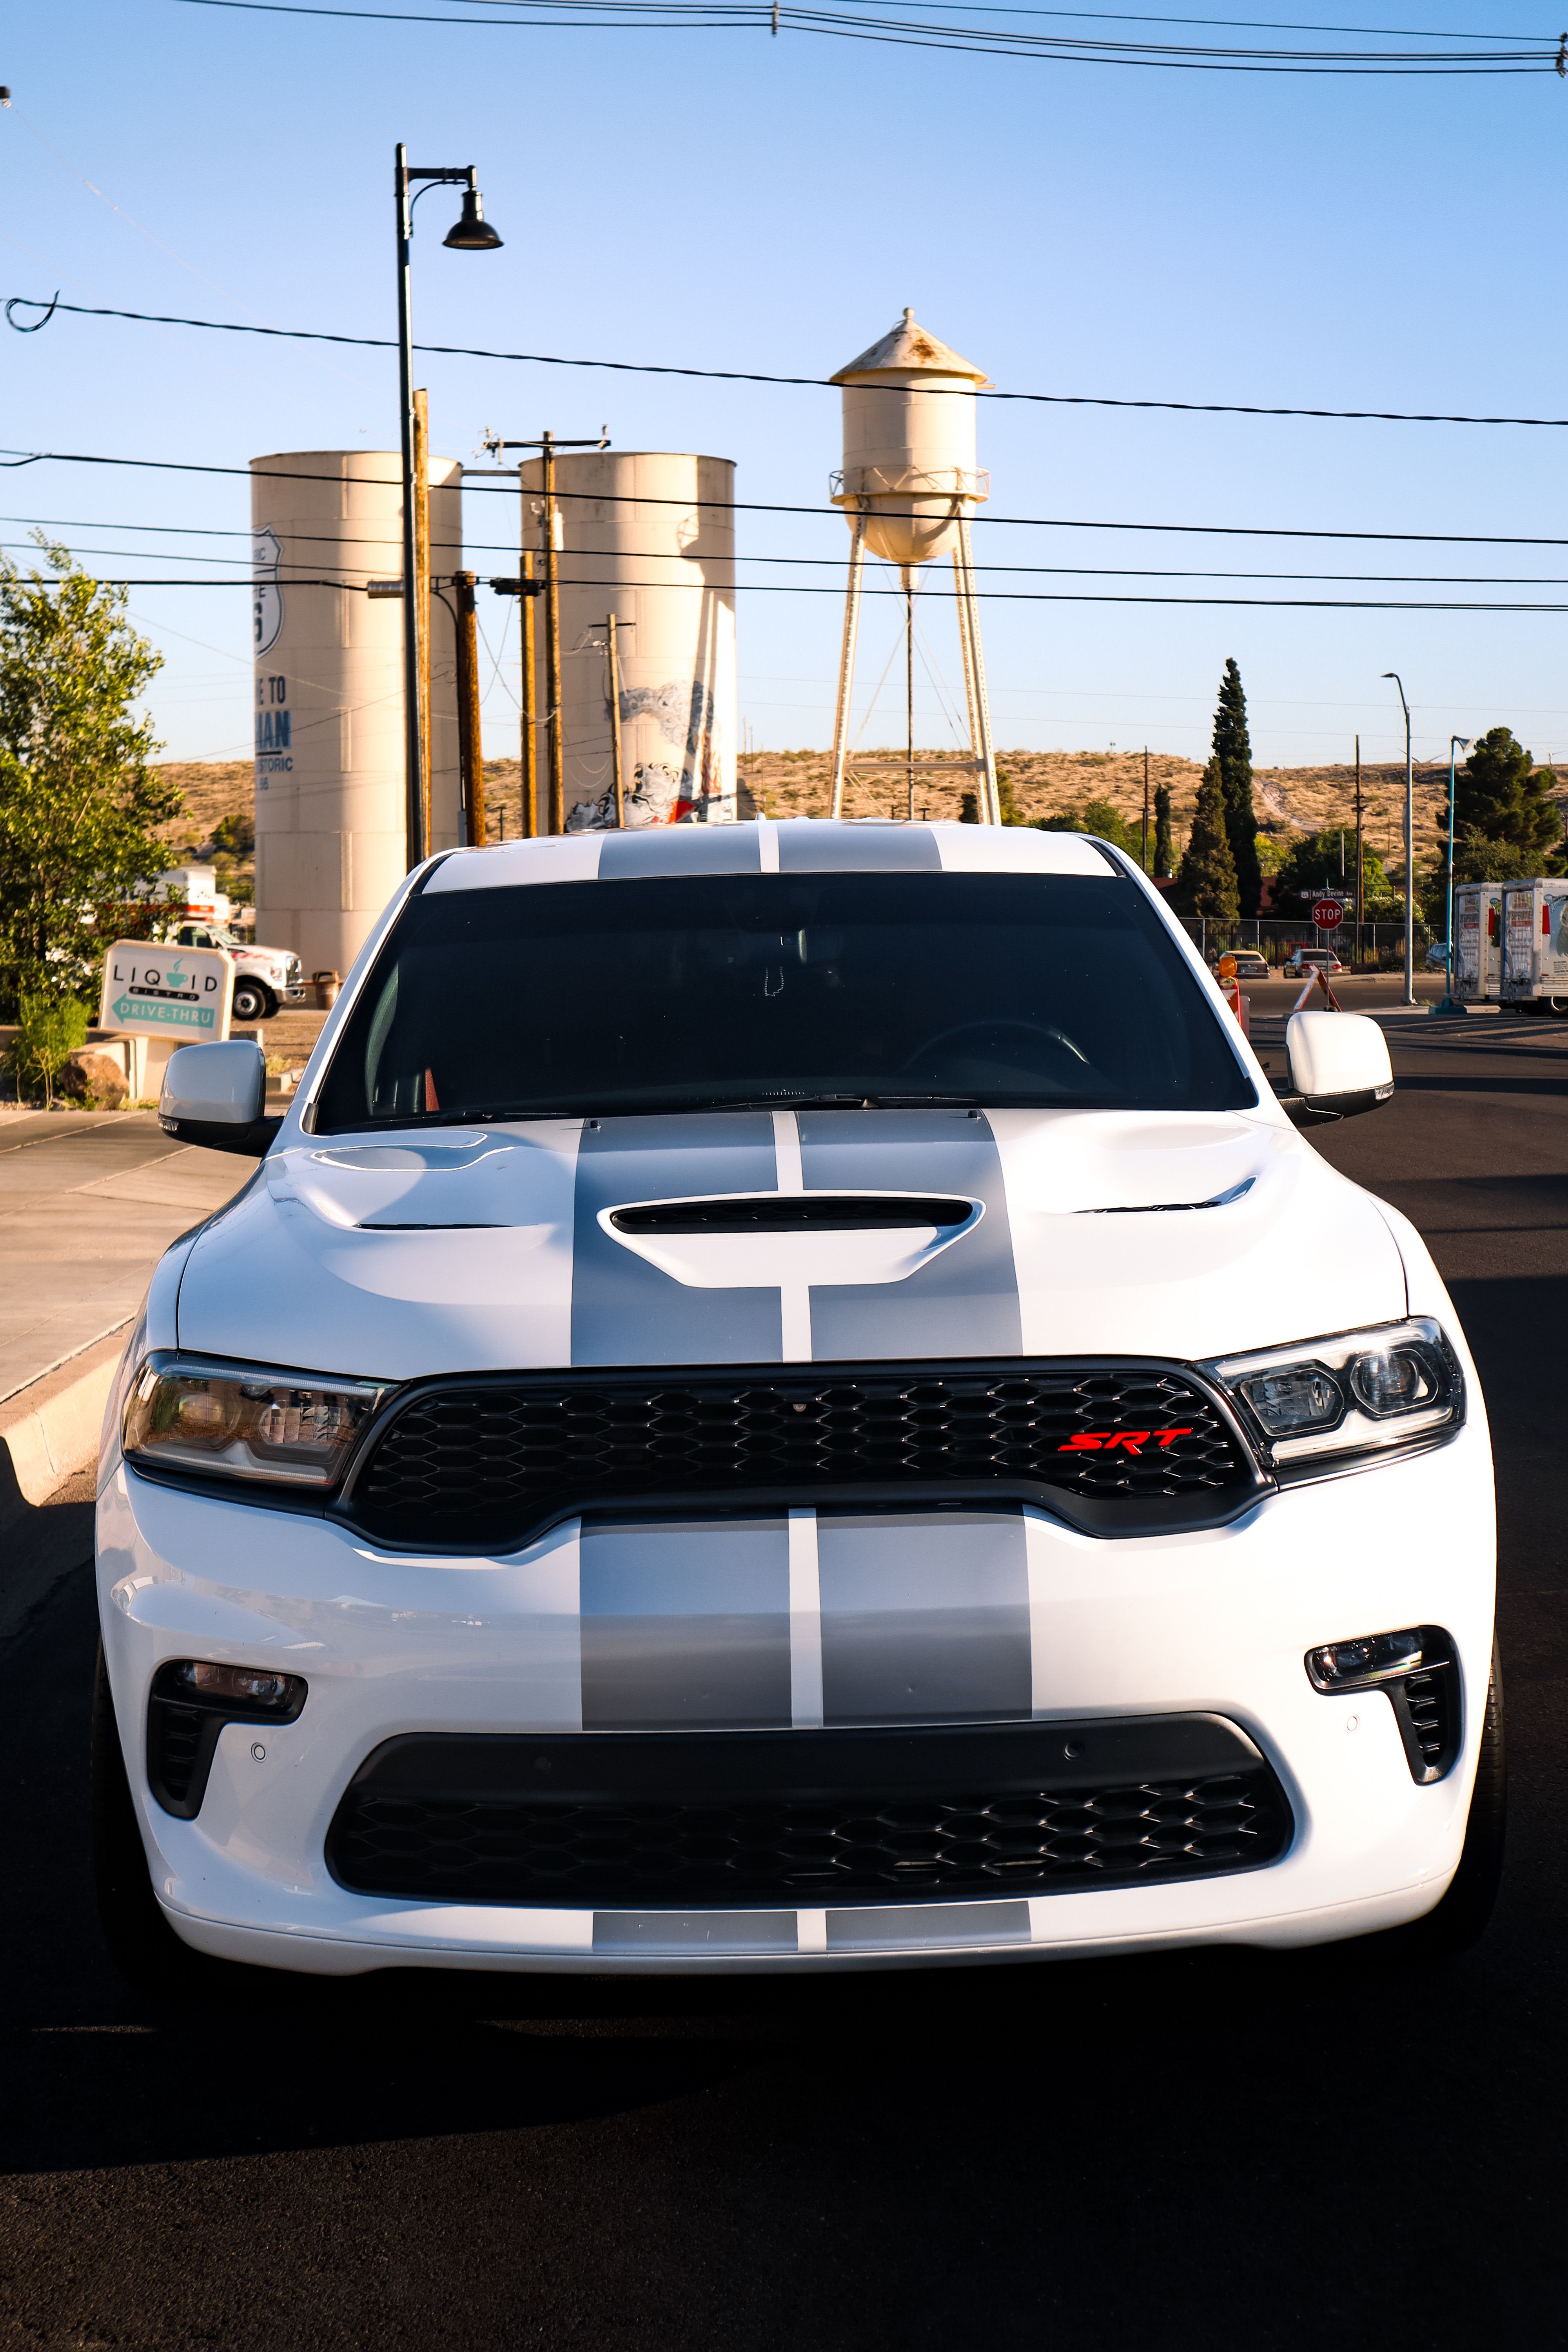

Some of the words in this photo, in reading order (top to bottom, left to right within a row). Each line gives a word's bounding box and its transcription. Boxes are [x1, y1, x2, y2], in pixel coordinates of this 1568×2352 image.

[269, 675, 286, 704] TO
[1314, 909, 1341, 920] STOP
[132, 987, 196, 1000] BISTRO
[120, 1002, 211, 1023] DRIVE-THRU
[1057, 1427, 1193, 1455] SRT
